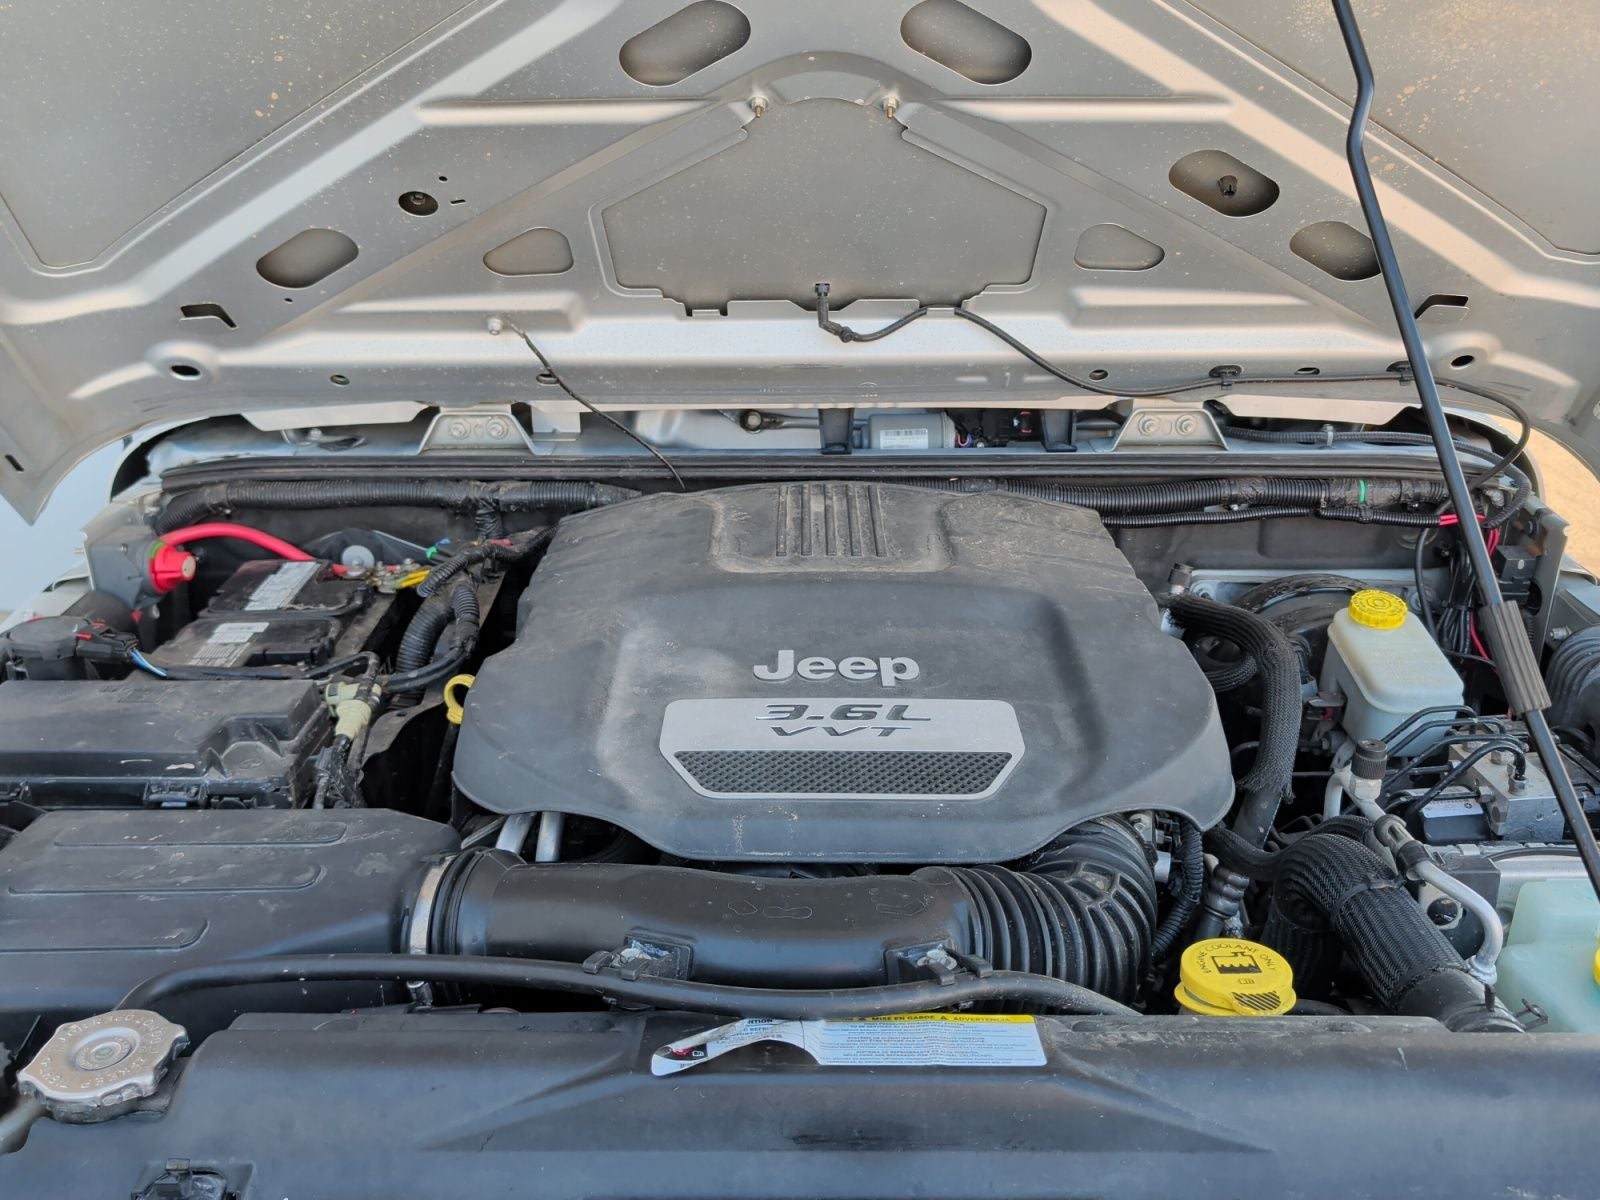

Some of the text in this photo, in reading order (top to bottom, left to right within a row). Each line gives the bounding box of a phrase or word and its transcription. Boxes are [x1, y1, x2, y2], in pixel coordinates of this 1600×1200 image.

[753, 649, 920, 688] Jeep
[755, 704, 931, 721] 3.6L
[770, 726, 911, 737] VVT
[1204, 943, 1258, 953] COOLANT
